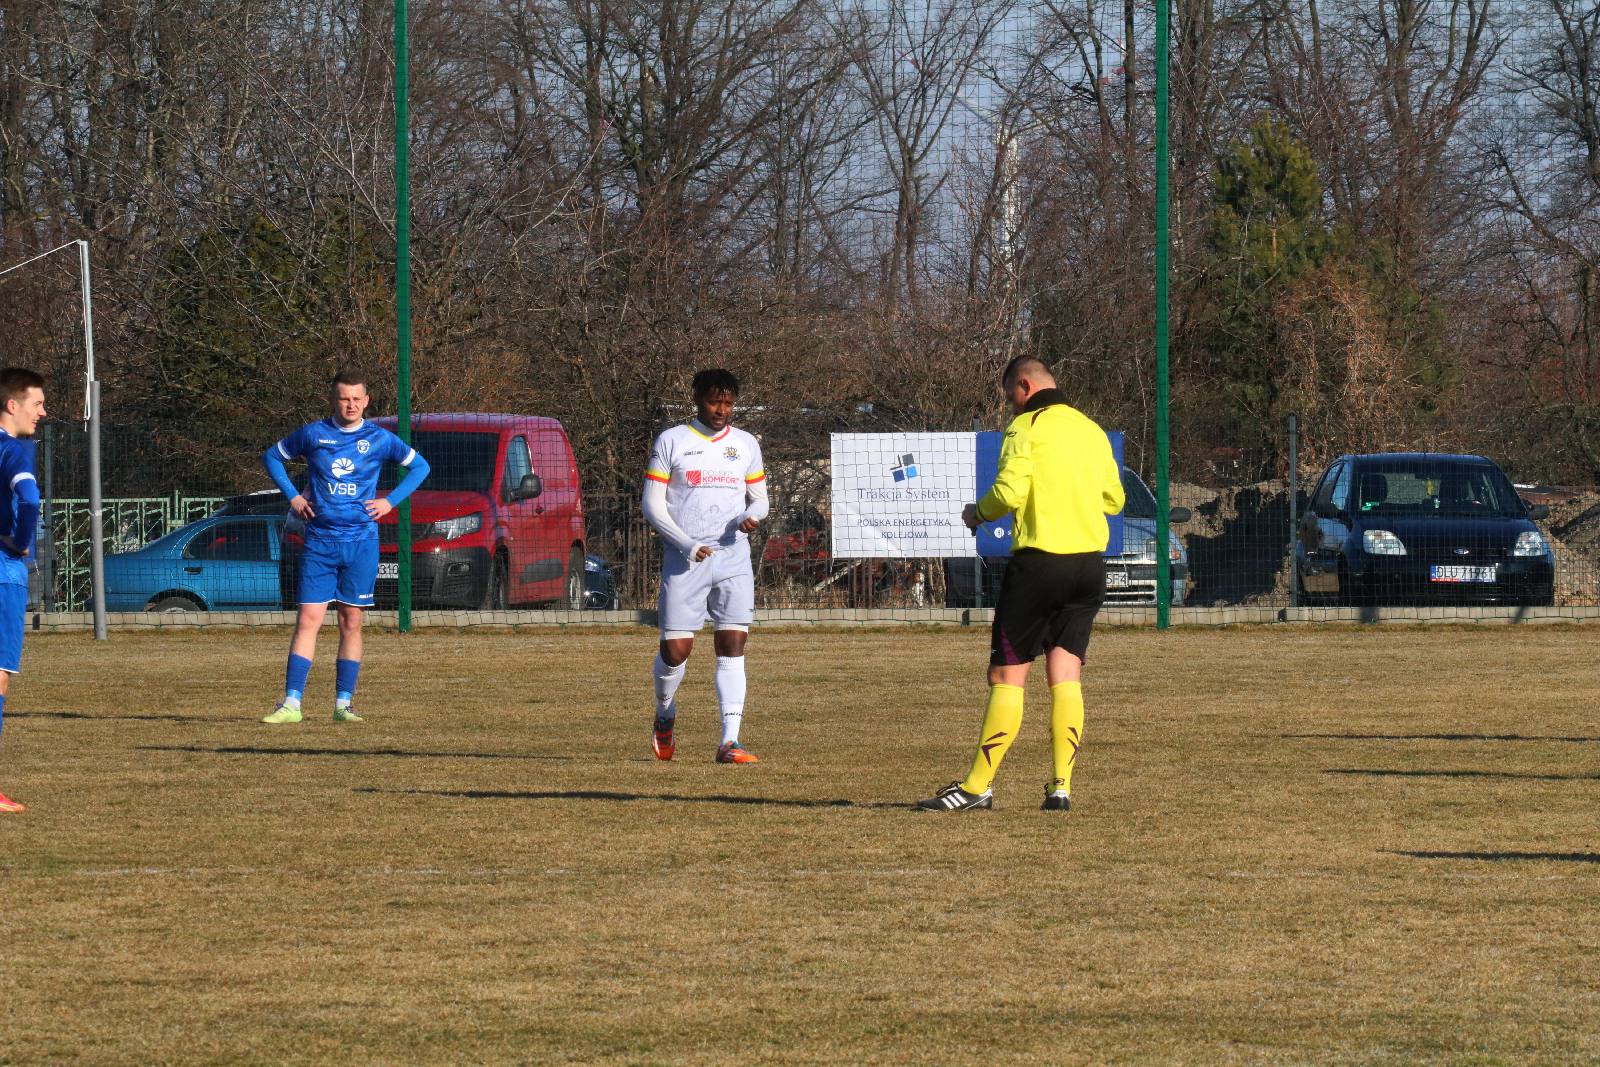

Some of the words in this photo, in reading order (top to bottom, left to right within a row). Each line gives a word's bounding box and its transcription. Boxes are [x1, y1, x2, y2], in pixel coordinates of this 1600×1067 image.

[328, 482, 357, 496] VSB
[857, 488, 902, 503] Trakcja
[905, 488, 950, 502] System
[857, 518, 891, 527] POLSKA
[893, 518, 951, 527] ENERGETYKA
[881, 530, 929, 539] KOLEJOWA
